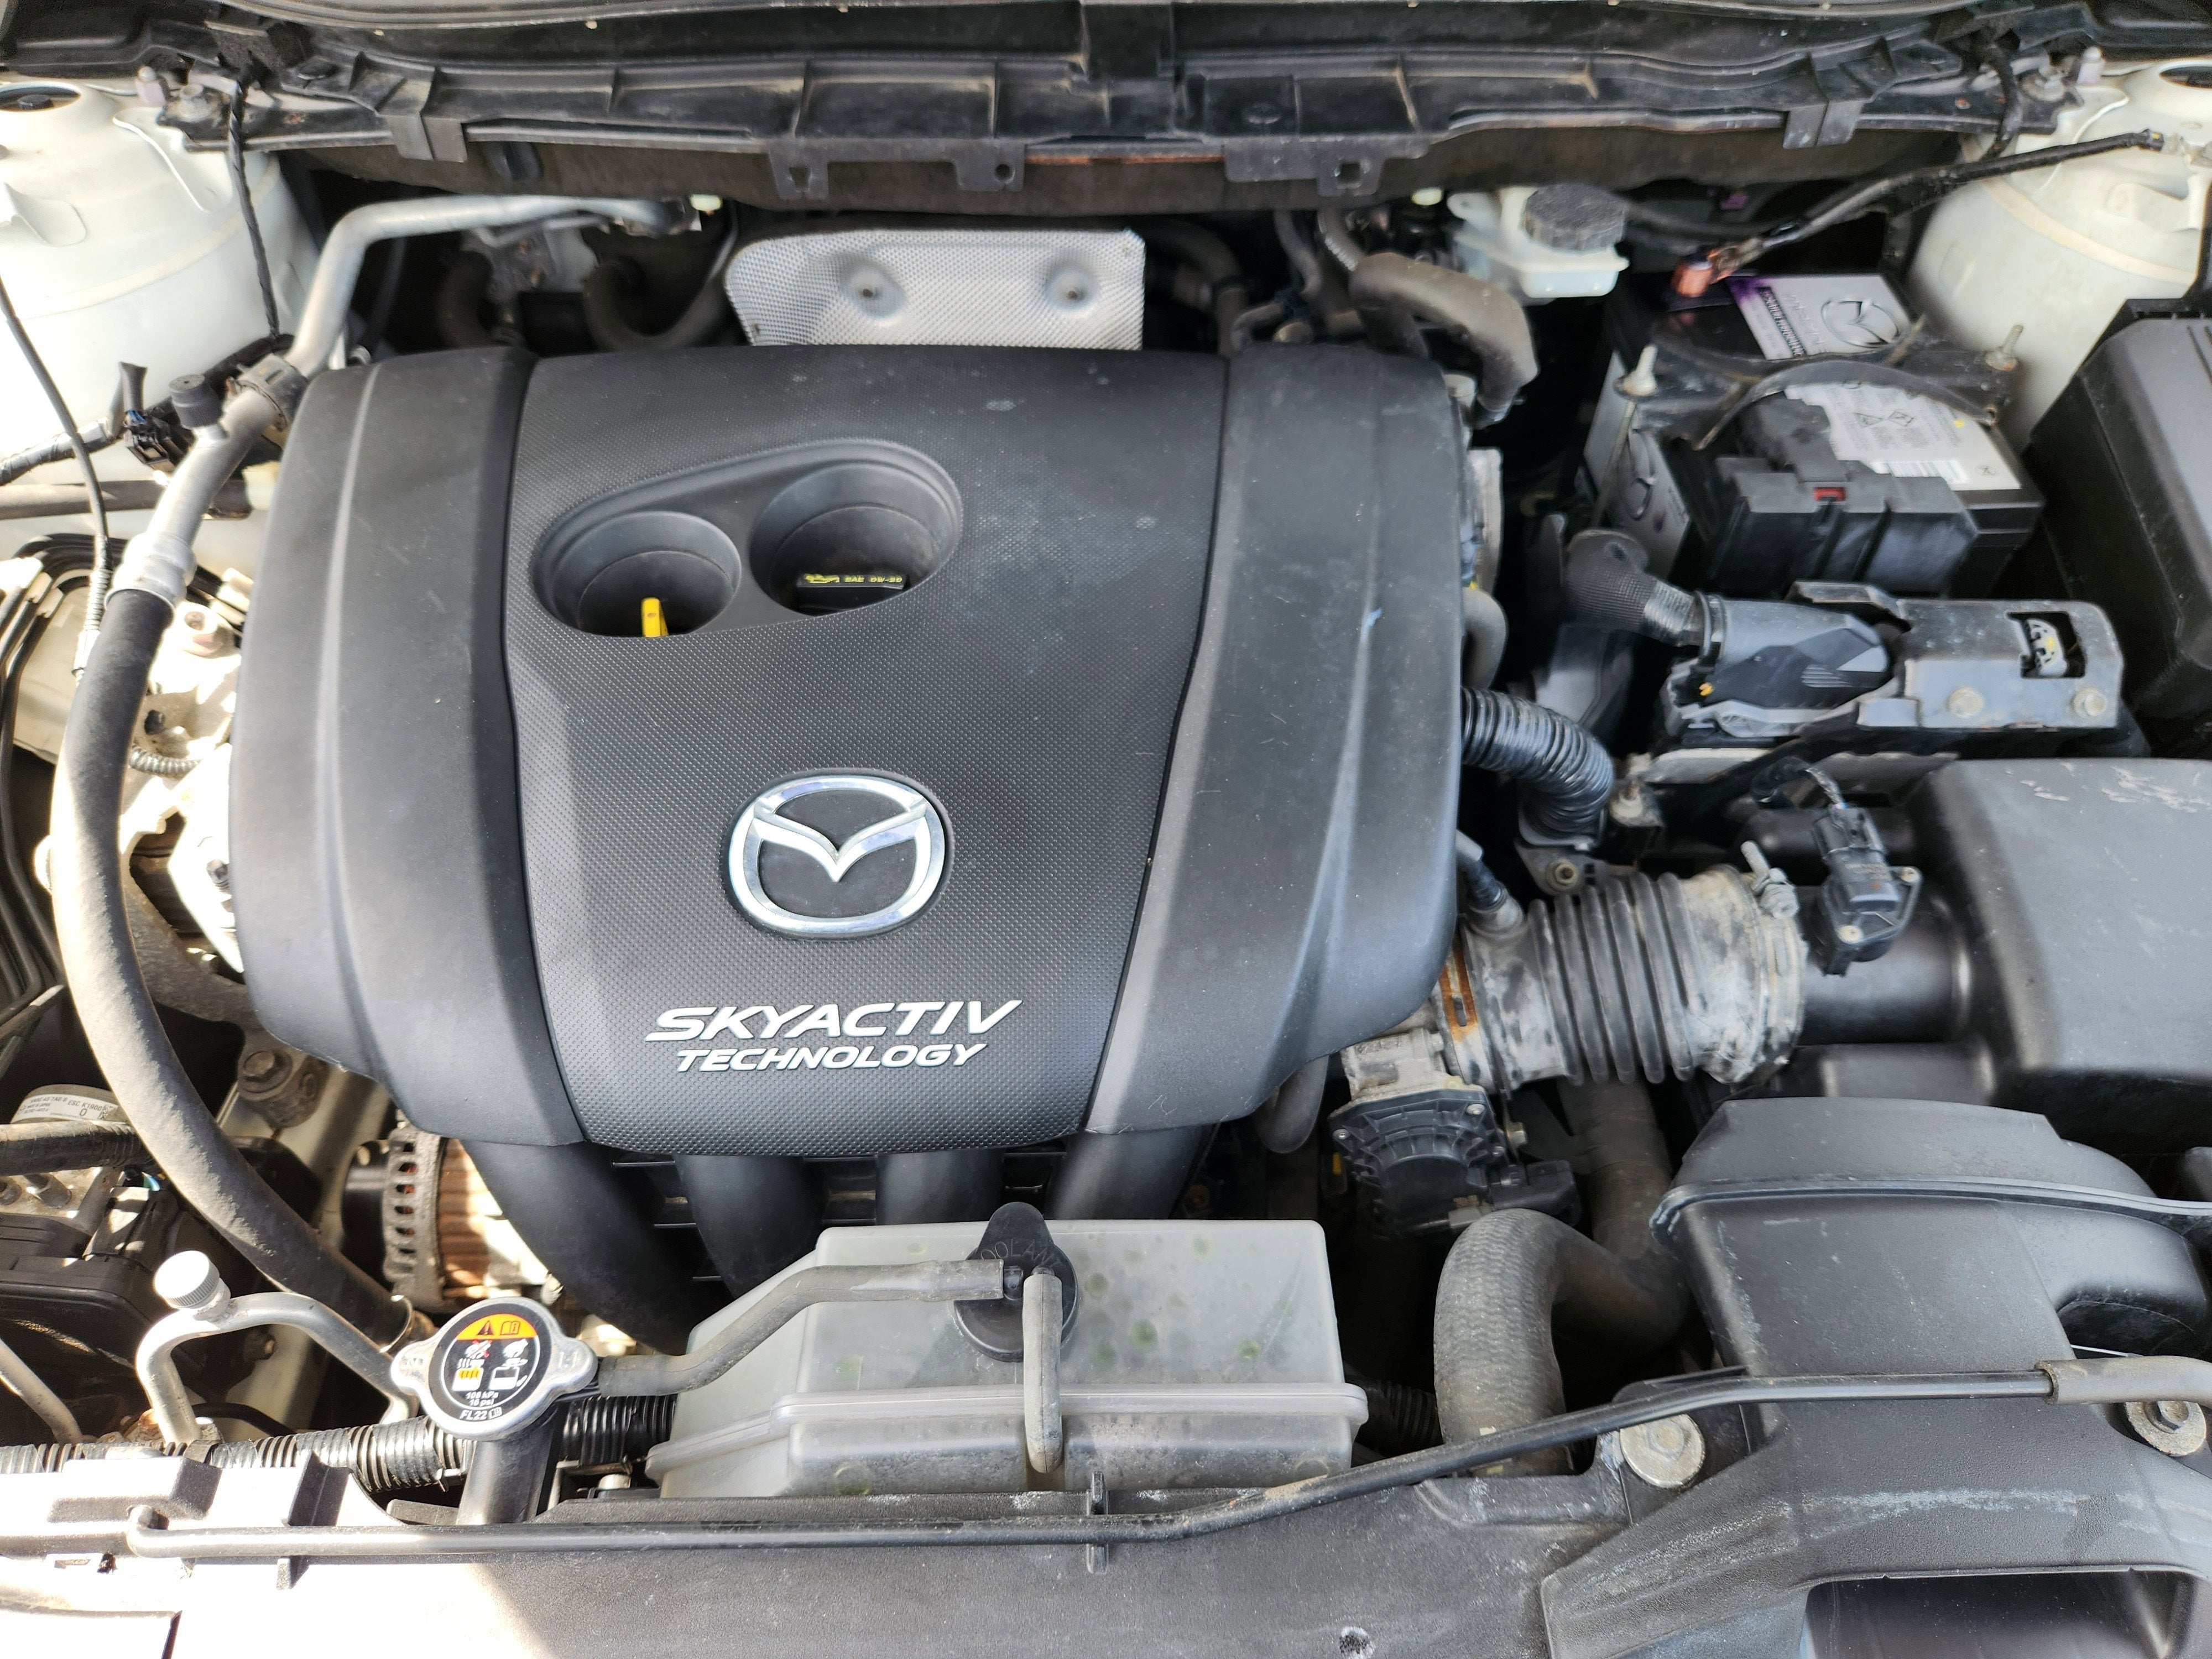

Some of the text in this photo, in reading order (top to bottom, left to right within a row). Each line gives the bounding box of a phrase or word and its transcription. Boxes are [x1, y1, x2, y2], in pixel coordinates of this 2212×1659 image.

[644, 999, 1023, 1042] SKYACTIV
[676, 1042, 988, 1072] TECHNOLOGY
[465, 1391, 499, 1400] 108 kPa
[479, 1398, 494, 1407] psi
[460, 1409, 488, 1420] FL22
